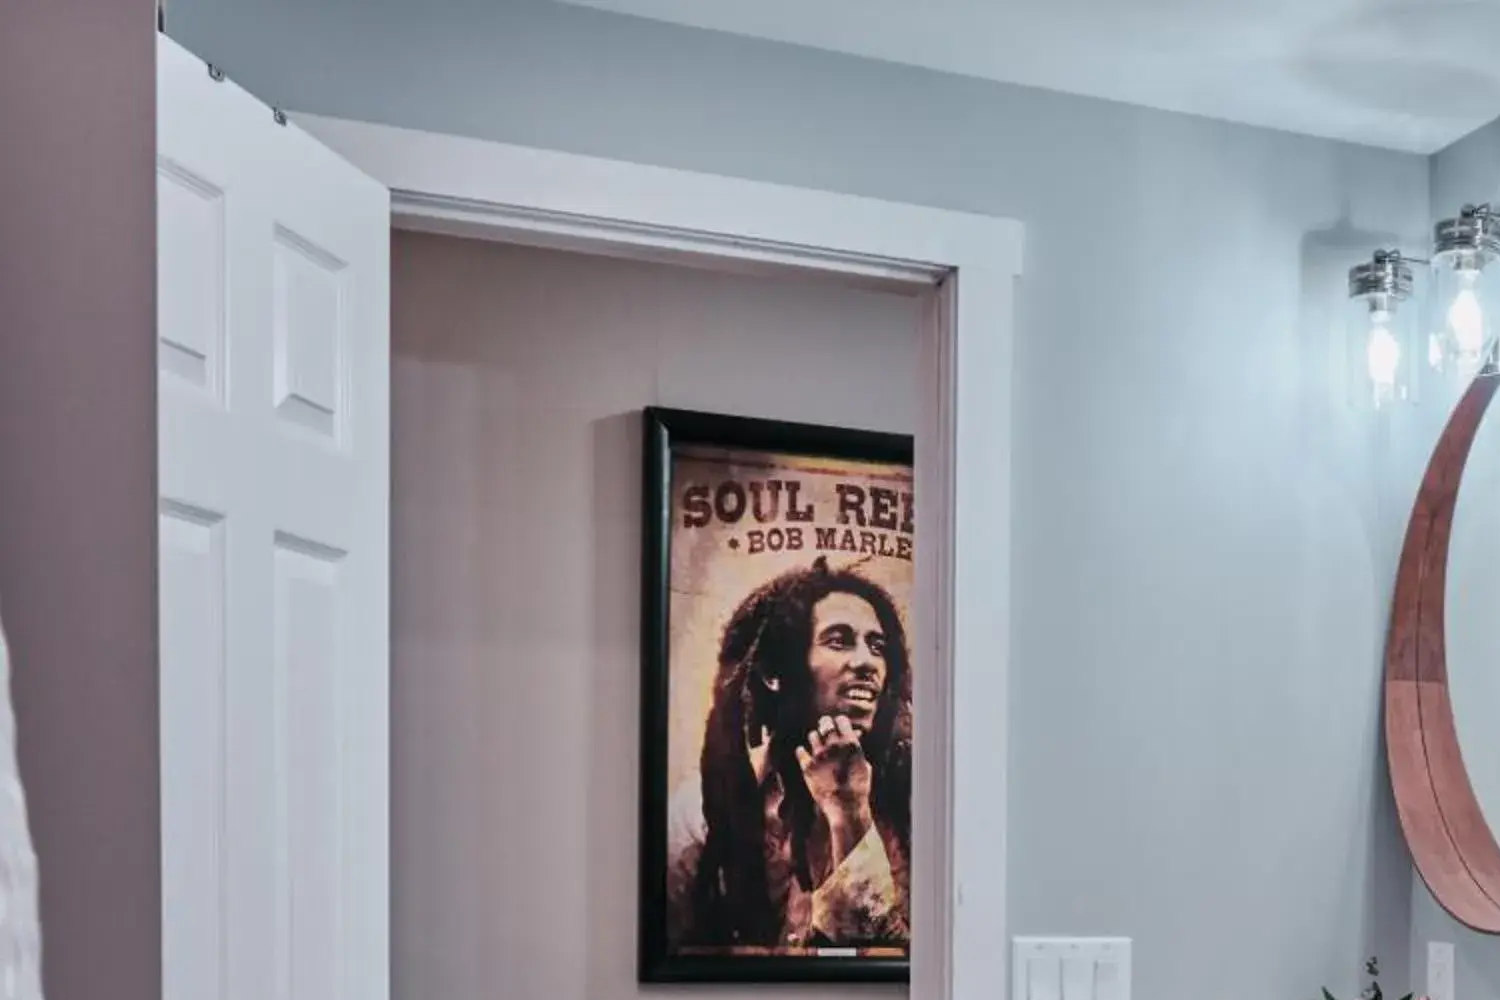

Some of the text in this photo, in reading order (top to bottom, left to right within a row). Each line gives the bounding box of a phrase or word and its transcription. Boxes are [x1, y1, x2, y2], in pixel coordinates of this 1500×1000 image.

[684, 480, 814, 528] SOUL
[747, 527, 912, 559] BOB MARLE
